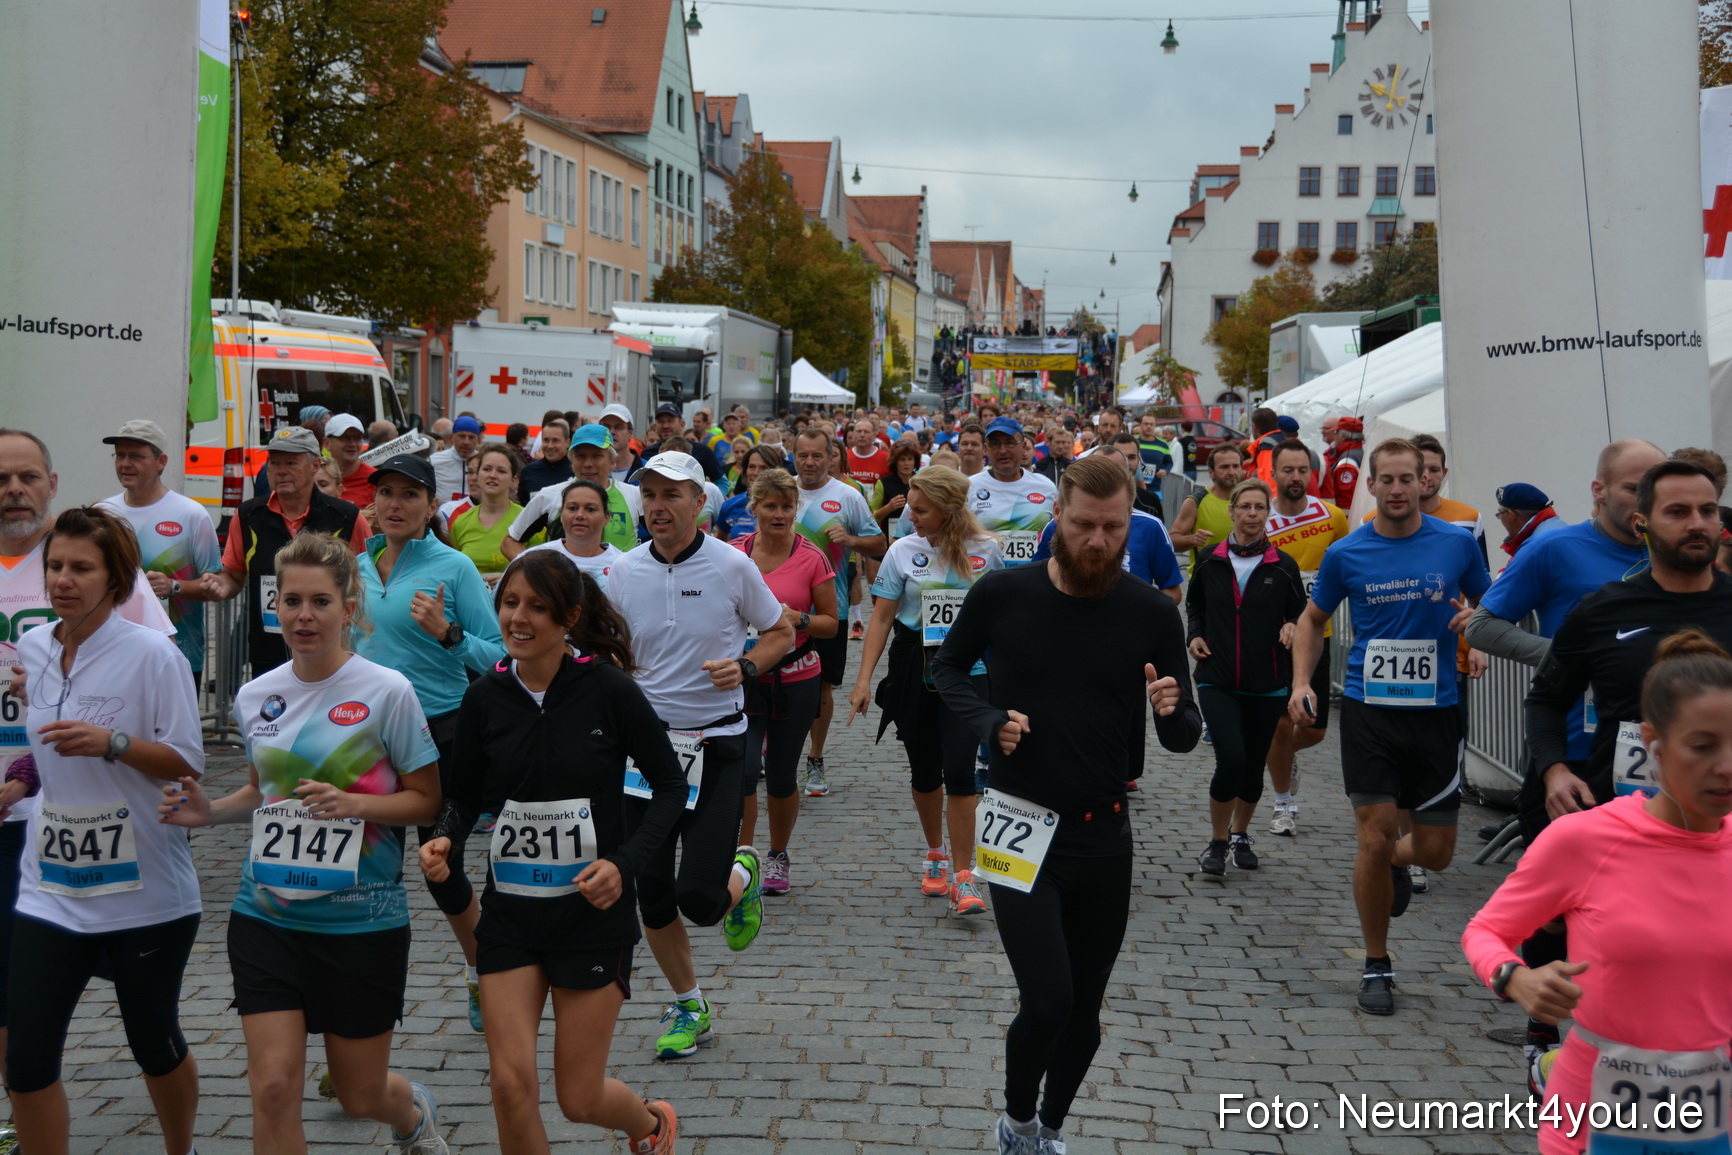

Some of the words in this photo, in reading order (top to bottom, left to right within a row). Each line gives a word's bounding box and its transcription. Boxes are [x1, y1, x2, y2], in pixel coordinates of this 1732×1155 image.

[1486, 329, 1702, 359] www.bmw-laufsport.de
[1005, 358, 1041, 368] START
[522, 367, 573, 378] Bayerisches
[522, 378, 546, 387] Rotes
[521, 388, 546, 397] Kreuz
[1301, 522, 1335, 540] BÖGL
[1001, 541, 1035, 559] 453
[1365, 578, 1420, 593] Kirwaläufer
[1366, 591, 1422, 605] Pettenhofen
[1368, 645, 1389, 653] PARTL
[1390, 645, 1425, 653] Neumarkt
[1371, 655, 1431, 680] 2146
[1387, 686, 1414, 696] Michi
[334, 708, 365, 721] Hervis
[61, 812, 112, 824] Neumarkt
[523, 810, 575, 821] Neumarkt
[996, 800, 1041, 822] Neumarkt
[981, 810, 1033, 854] 272
[43, 823, 123, 863] 2647
[262, 822, 353, 864] 2147
[500, 824, 582, 860] 2311
[982, 853, 1011, 872] Markus
[65, 869, 103, 885] Silvia
[284, 870, 318, 887] Julia
[533, 868, 552, 883] Evi
[1599, 1056, 1653, 1077] PARTL
